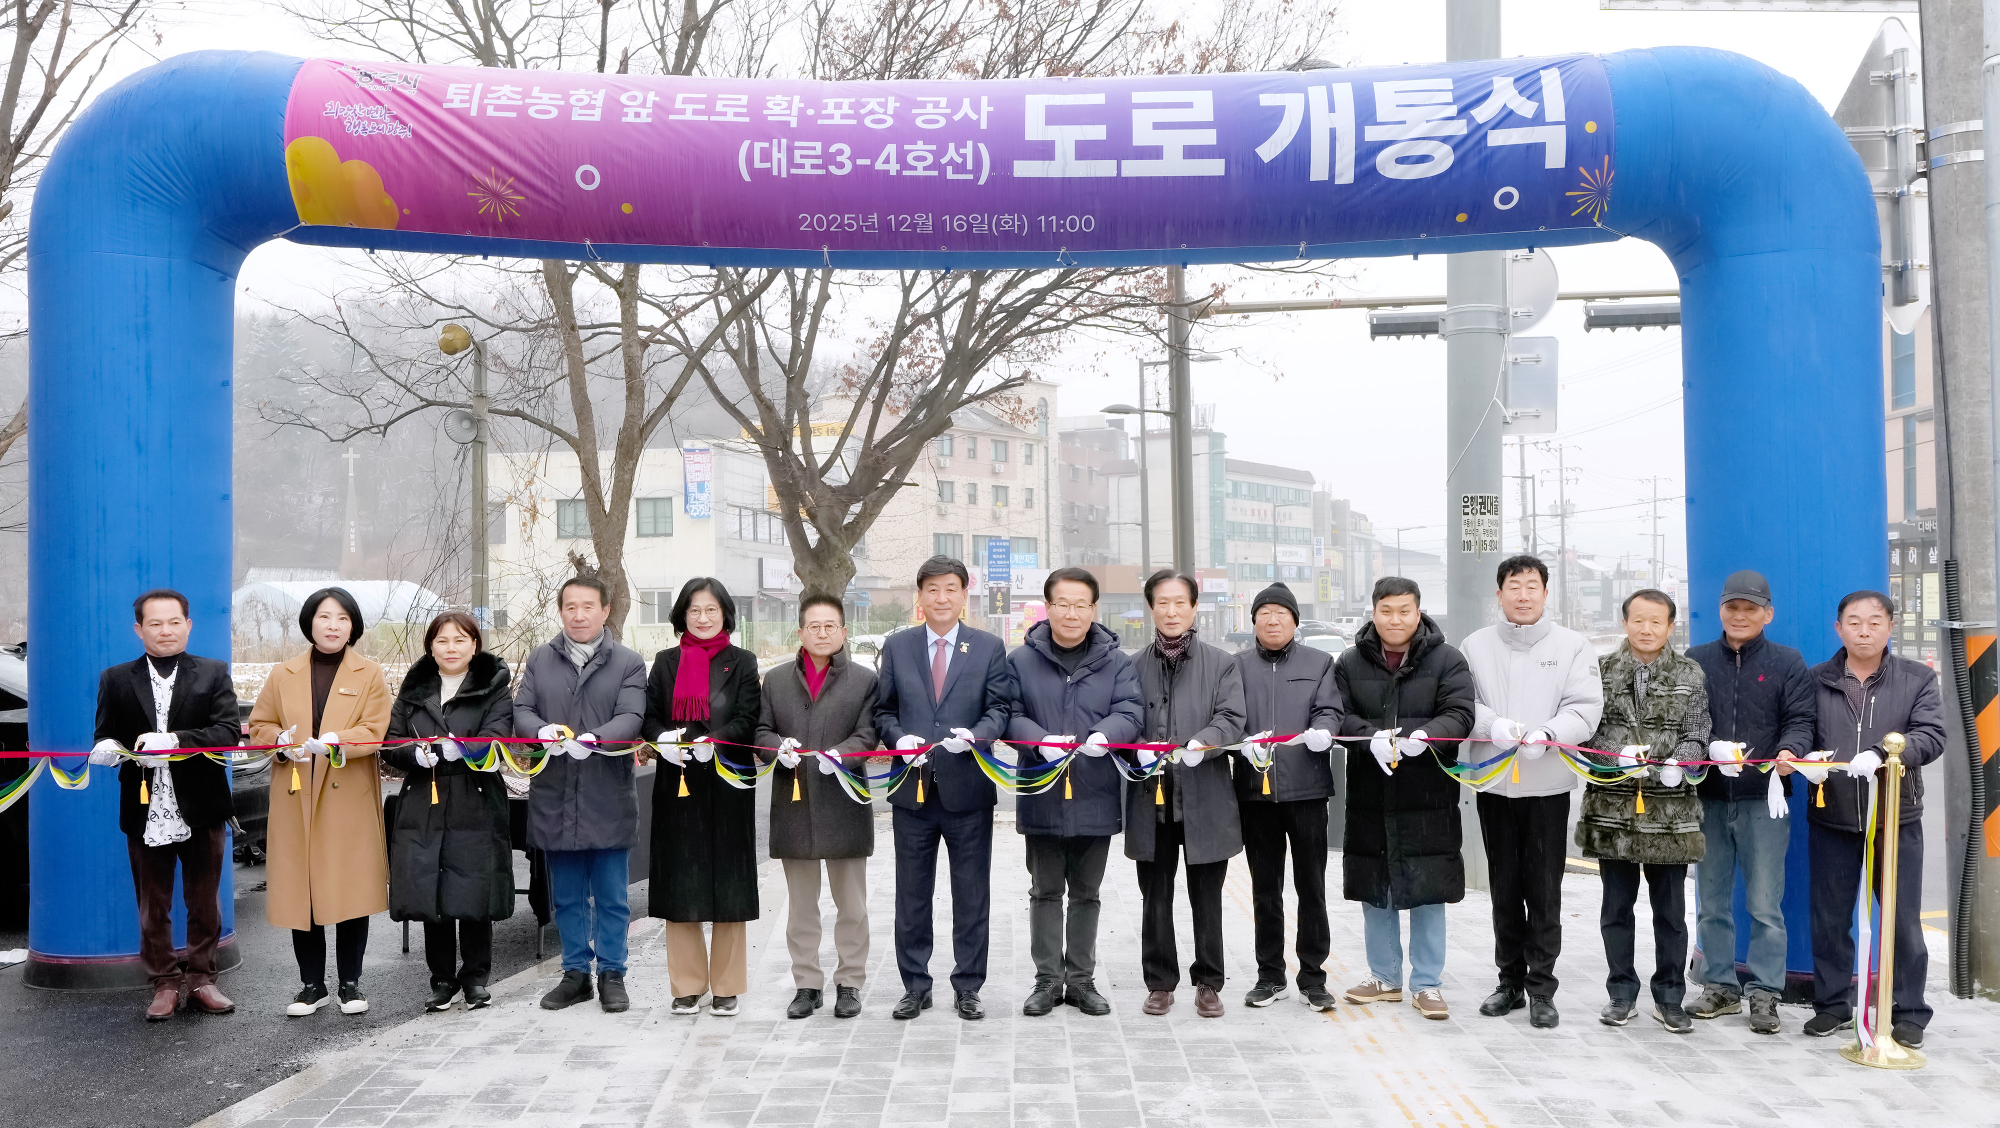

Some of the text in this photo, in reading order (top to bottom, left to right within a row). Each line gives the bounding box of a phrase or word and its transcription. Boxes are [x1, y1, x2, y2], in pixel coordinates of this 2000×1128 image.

[441, 82, 993, 131] 퇴촌농협 앞 도로 확·포장 공사
[1013, 67, 1568, 185] 도로 개통식
[737, 137, 992, 186] (대로3-4호선)
[798, 212, 1095, 237] 2025년 12월 16일(화) 11:00
[1462, 495, 1499, 516] 은행권대출
[1916, 599, 1921, 613] ME
